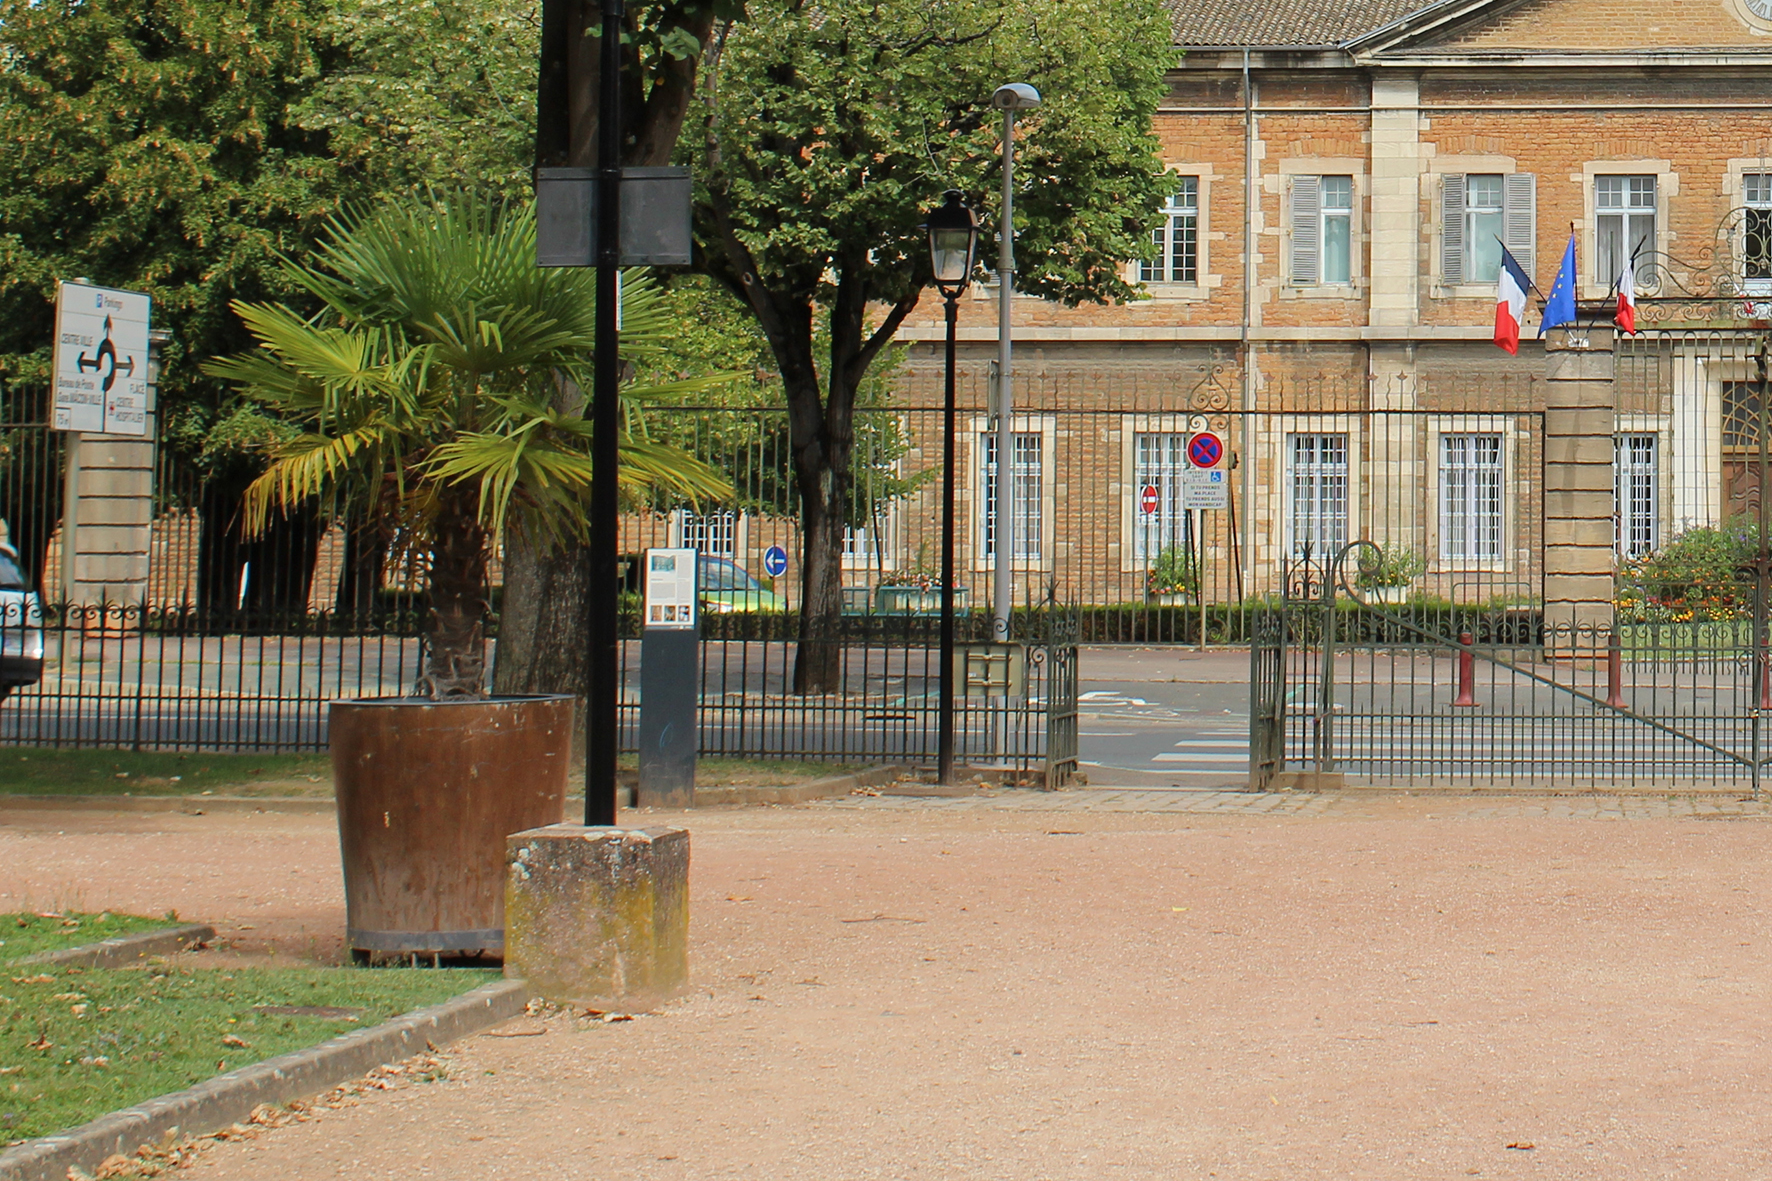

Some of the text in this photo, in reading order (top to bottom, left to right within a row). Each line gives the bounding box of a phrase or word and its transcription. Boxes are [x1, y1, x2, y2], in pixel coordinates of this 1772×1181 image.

[61, 333, 93, 347] CENTRE VILLE
[59, 377, 75, 388] Bureau
[116, 396, 134, 408] CENTRE
[115, 410, 144, 423] HOSPITALIER
